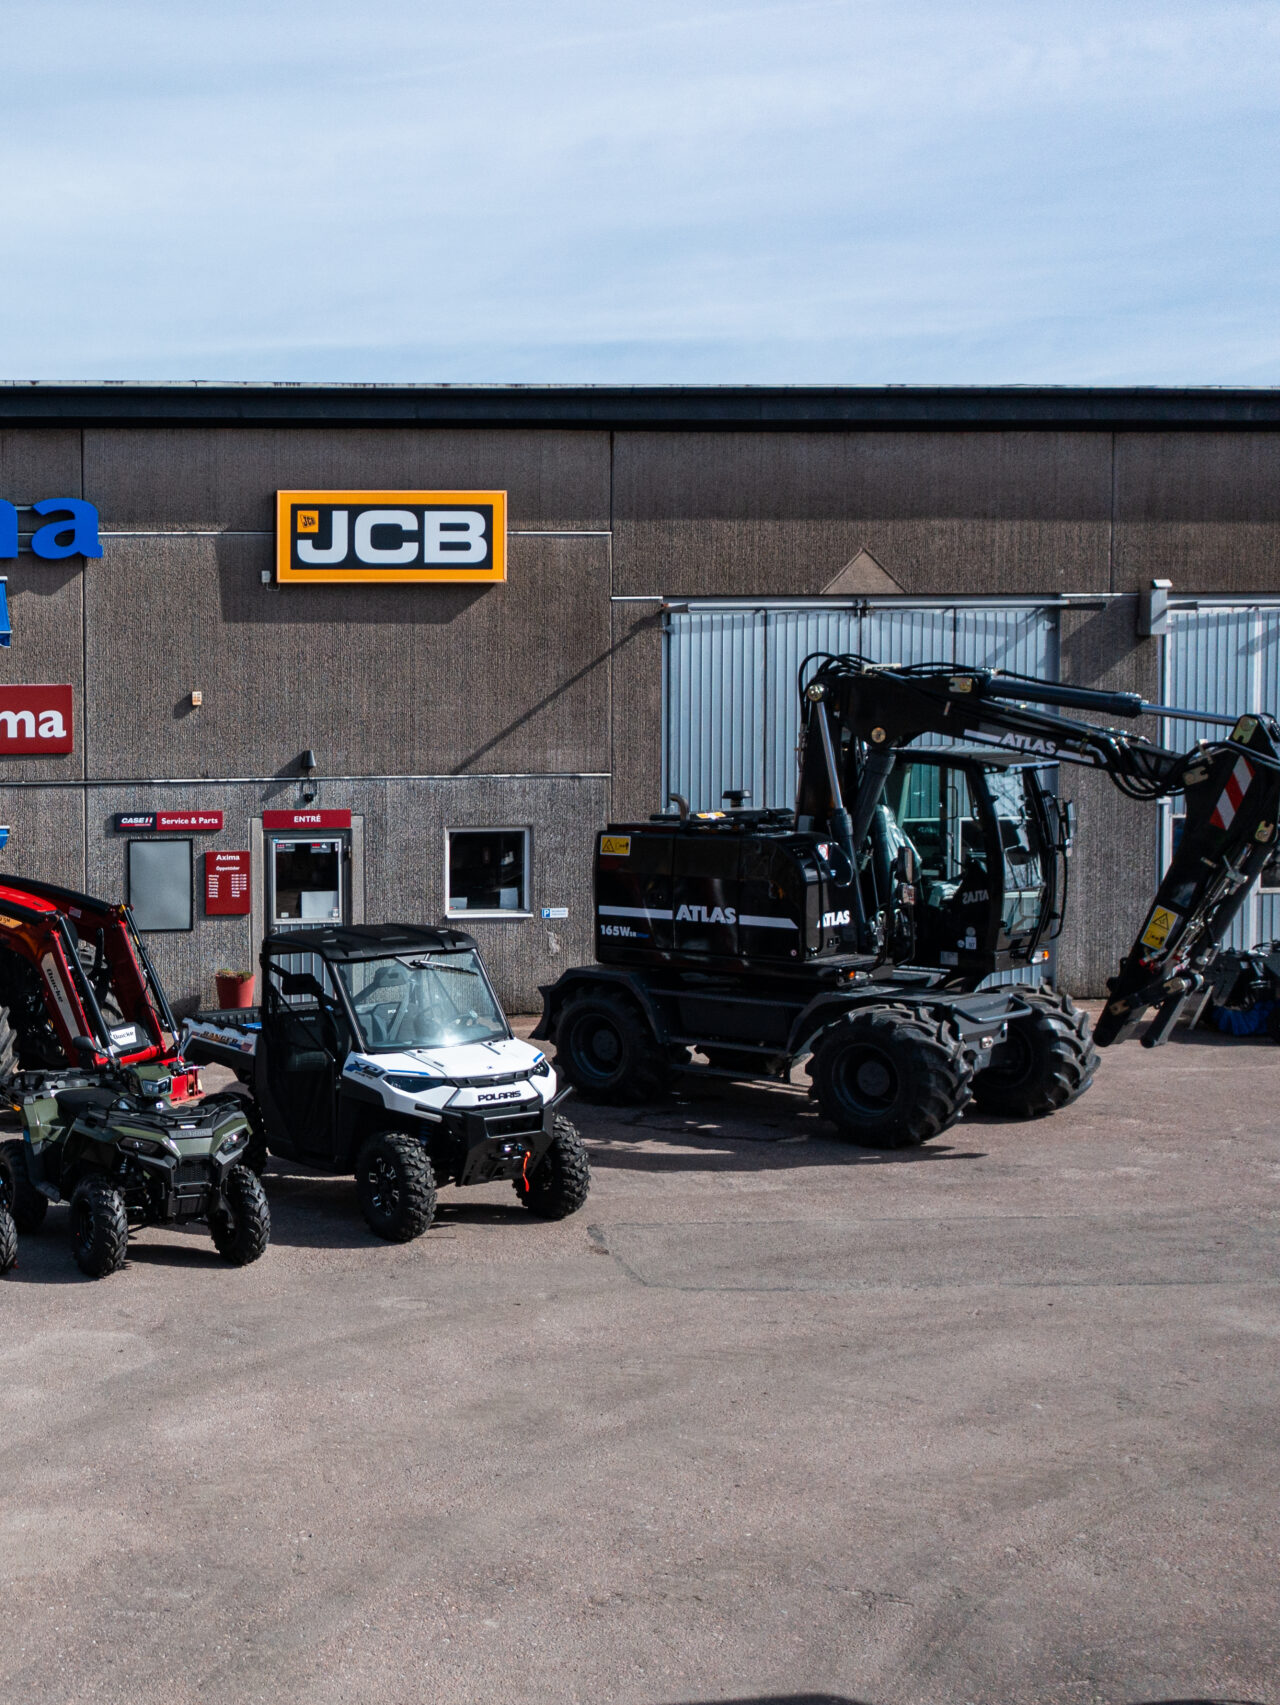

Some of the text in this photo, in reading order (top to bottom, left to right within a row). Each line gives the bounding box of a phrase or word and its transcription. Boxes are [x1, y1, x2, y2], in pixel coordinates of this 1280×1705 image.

[296, 509, 488, 564] JCB
[1001, 732, 1057, 755] ATLAS
[293, 813, 322, 823] ENTRÉ
[676, 904, 737, 924] ATLAS
[816, 909, 851, 928] ATLAS
[477, 1090, 522, 1102] POLARIS
